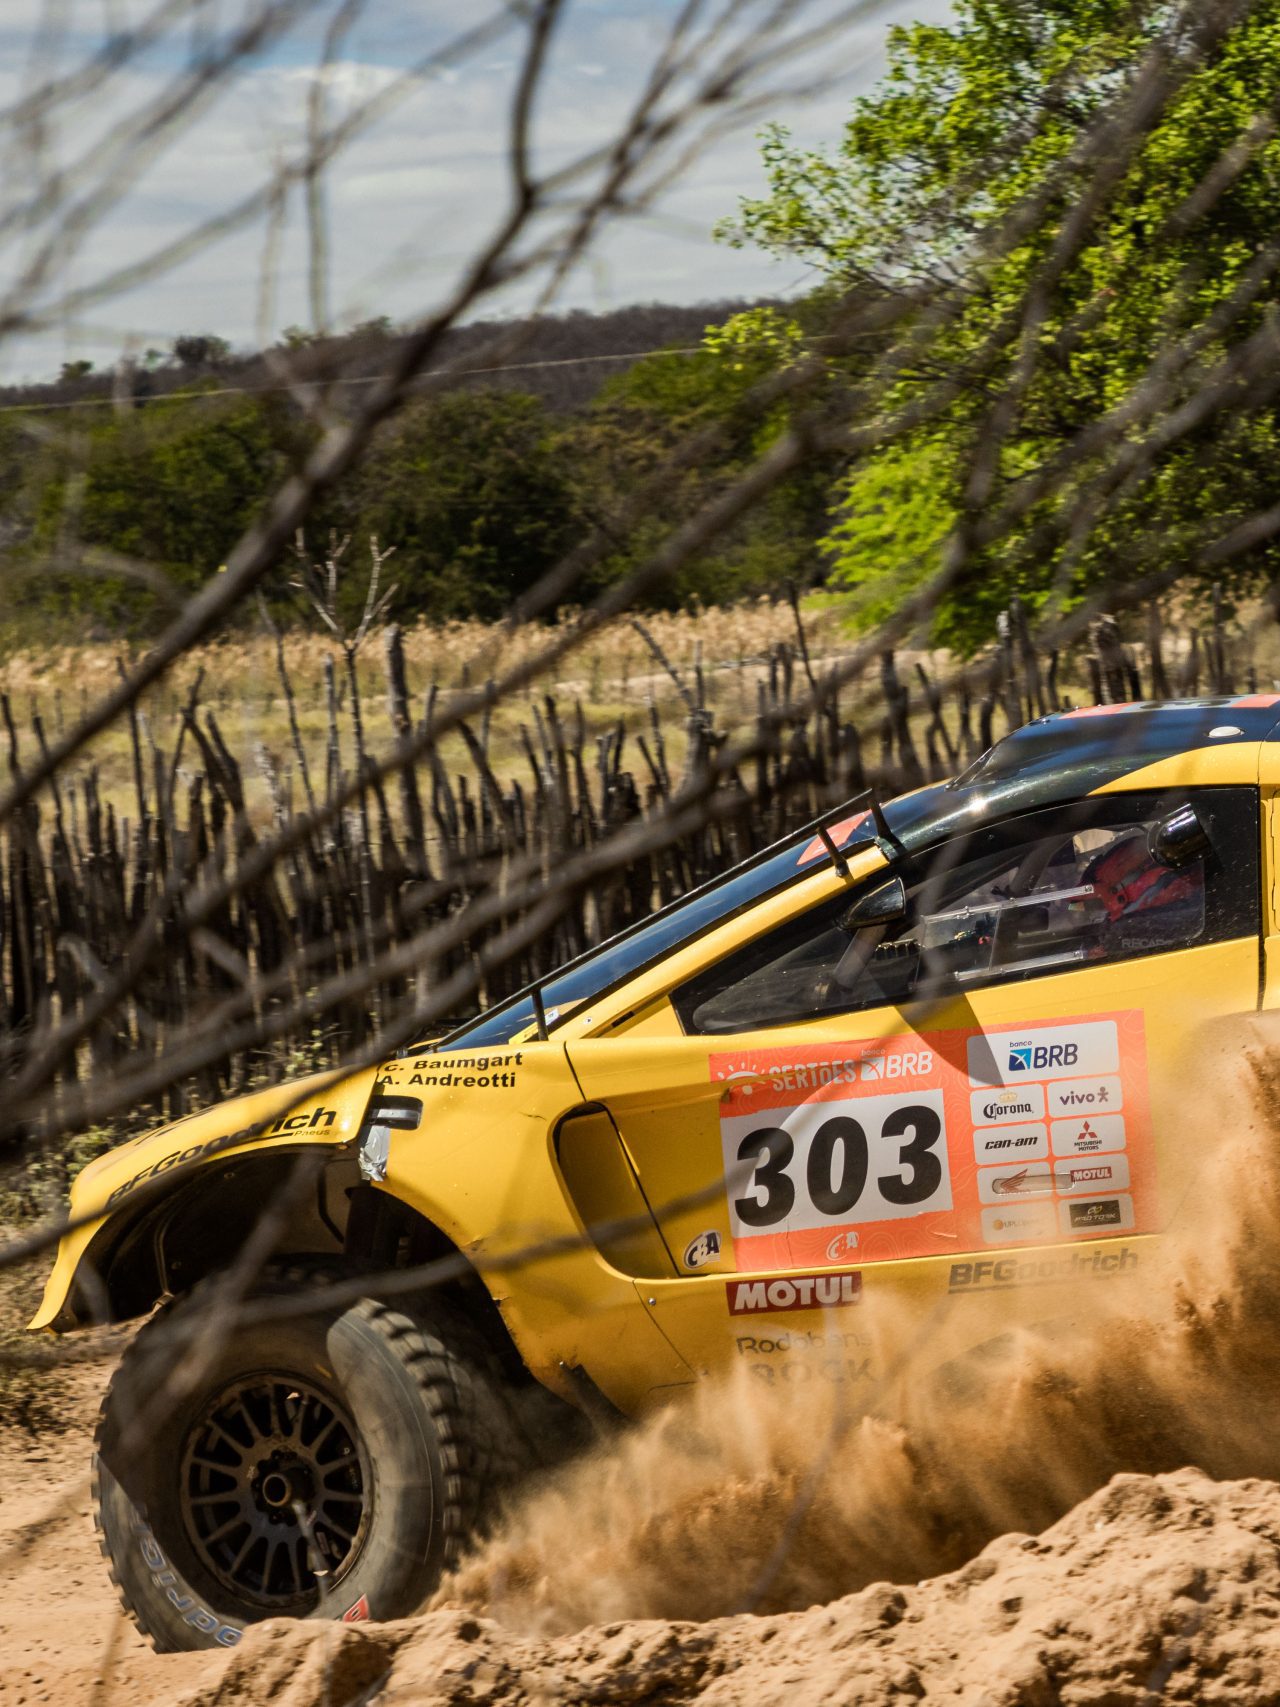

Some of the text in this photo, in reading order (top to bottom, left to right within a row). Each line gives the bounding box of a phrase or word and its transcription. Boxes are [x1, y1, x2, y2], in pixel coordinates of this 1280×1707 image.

[1009, 1040, 1033, 1048] banco
[384, 1052, 523, 1073] C. Baumgart
[885, 1051, 934, 1078] BRB
[1033, 1043, 1079, 1069] BRB
[380, 1072, 516, 1088] A. Andreotti
[1059, 1091, 1096, 1105] vivo
[983, 1102, 1032, 1120] Corona
[984, 1136, 1039, 1150] can-am
[1074, 1139, 1103, 1147] MITSUBISHI
[734, 1105, 942, 1227] 303
[1073, 1167, 1111, 1181] MOTUL
[734, 1275, 862, 1310] MOTUL
